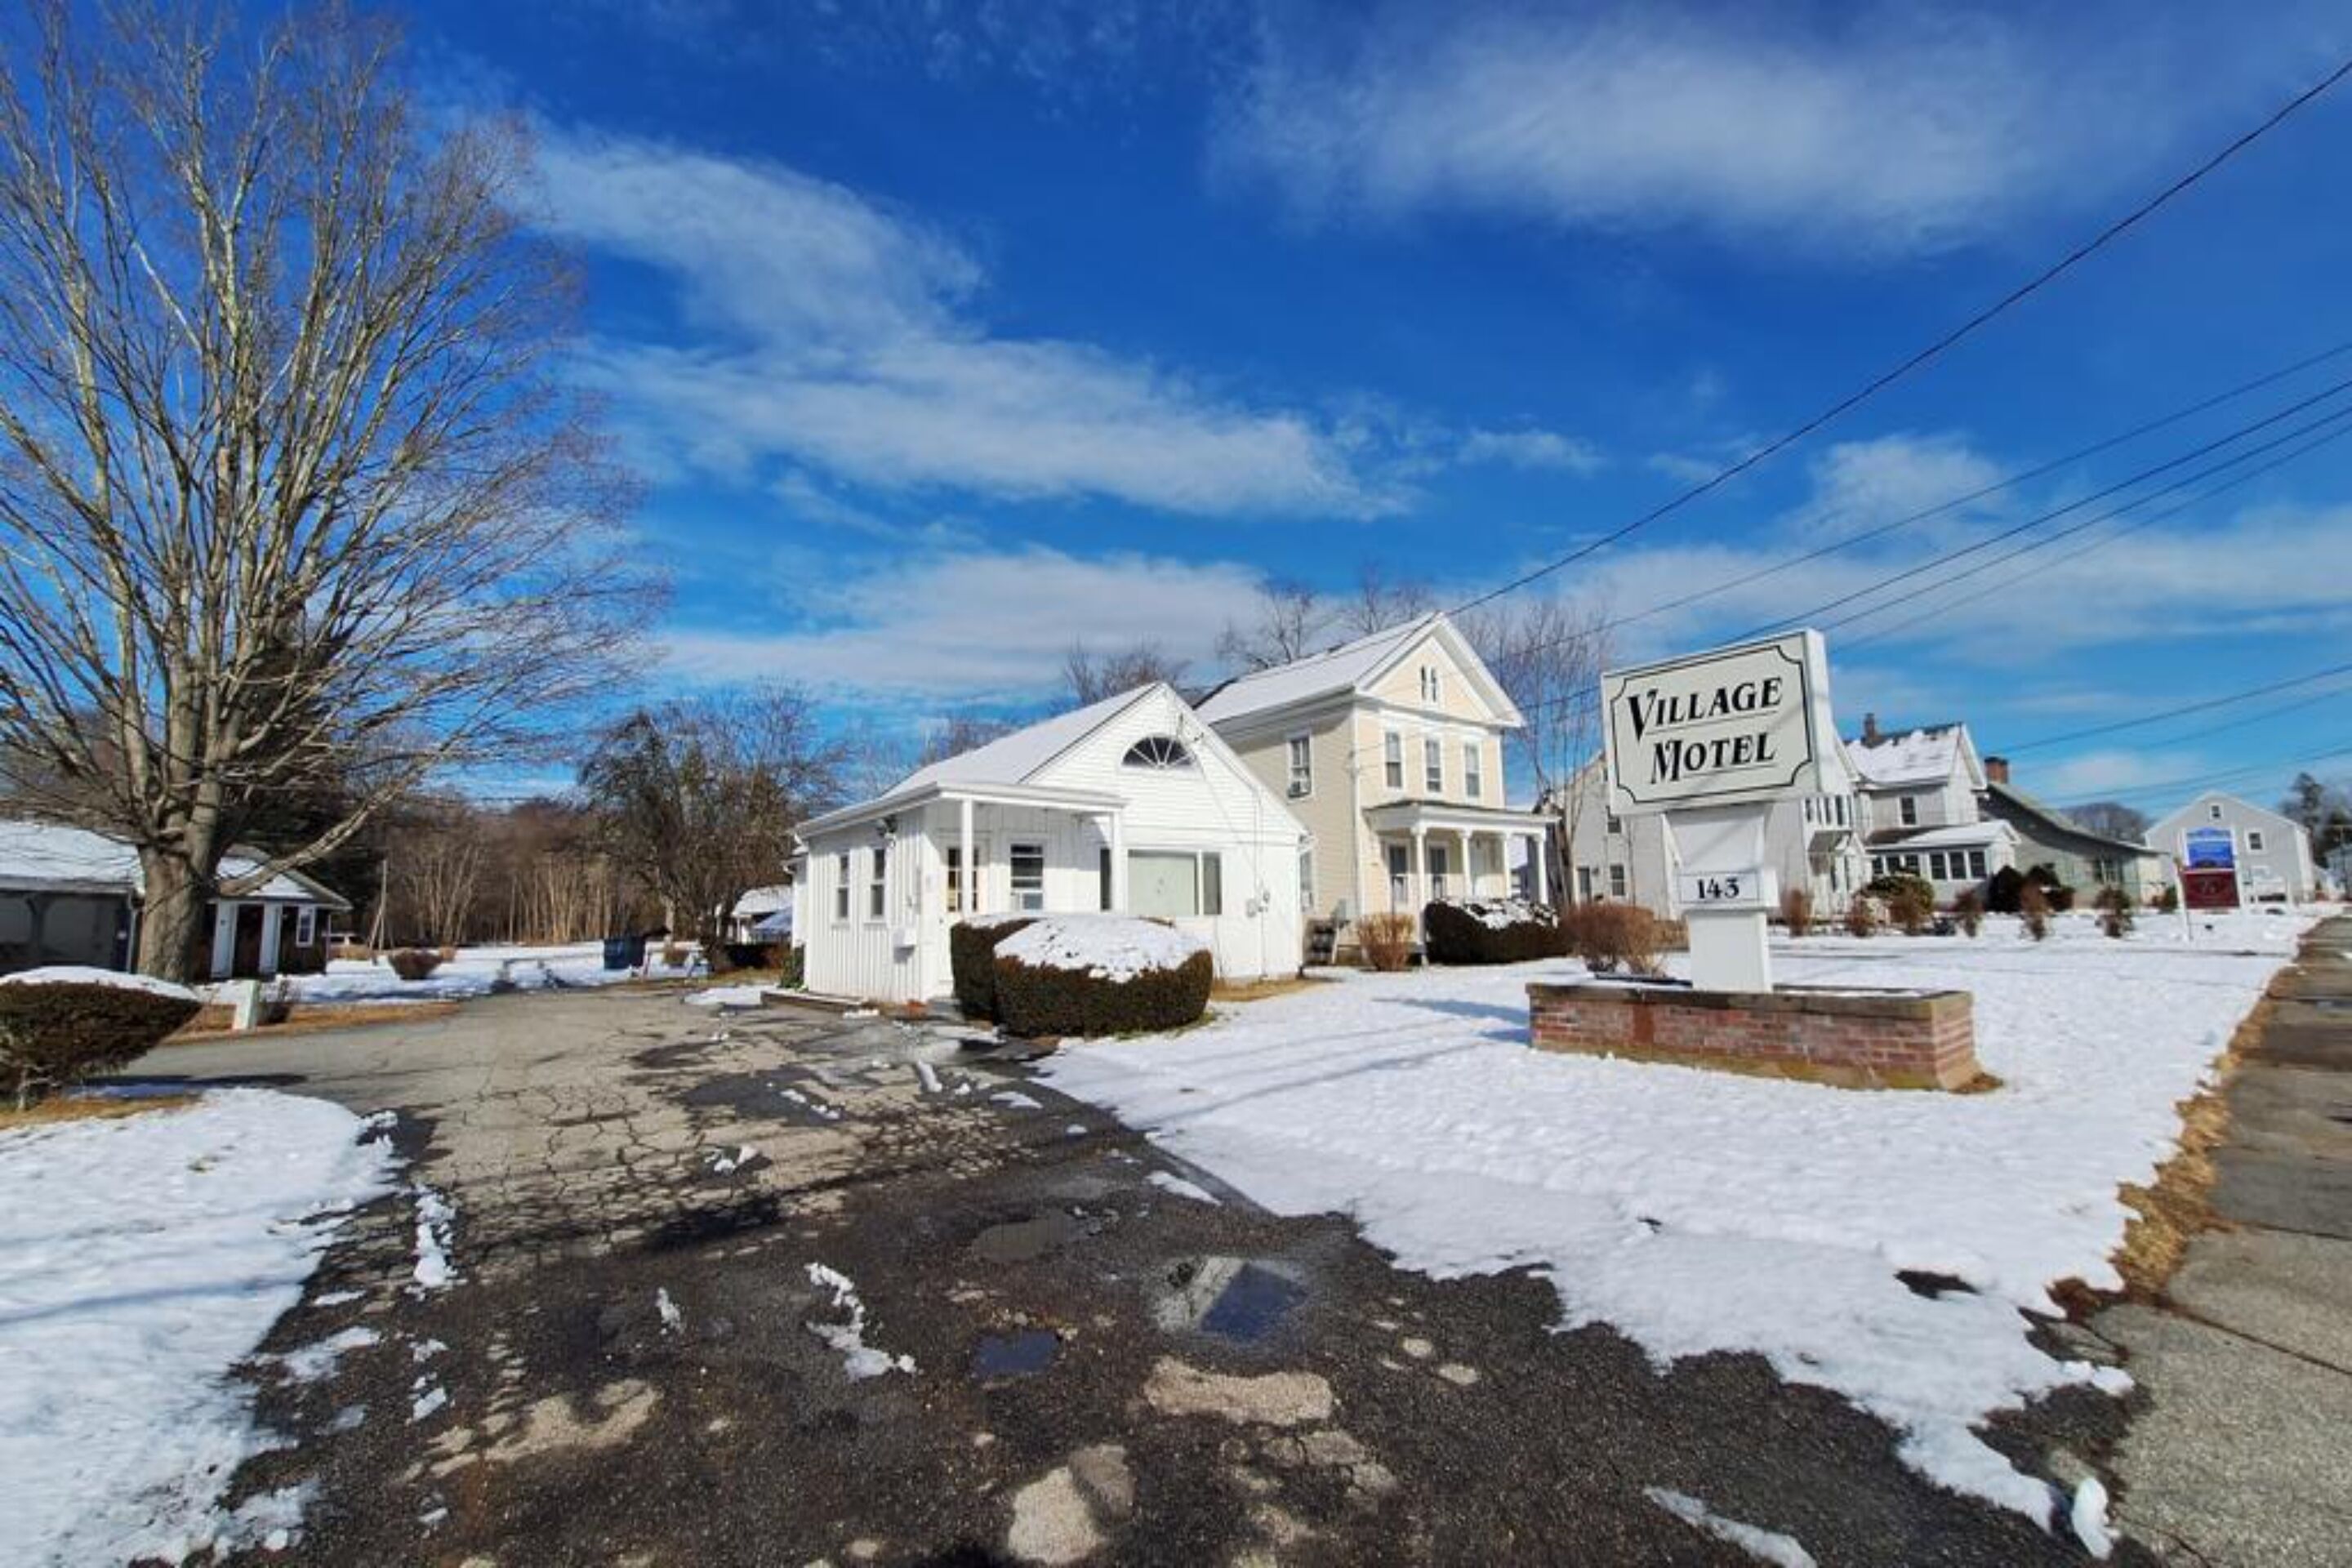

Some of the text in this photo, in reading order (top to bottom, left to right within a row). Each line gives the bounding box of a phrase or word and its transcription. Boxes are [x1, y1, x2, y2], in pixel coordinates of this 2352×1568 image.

[1628, 677, 1782, 742] VILLAGE
[1650, 733, 1775, 784] MOTEL
[1697, 878, 1740, 899] 143
